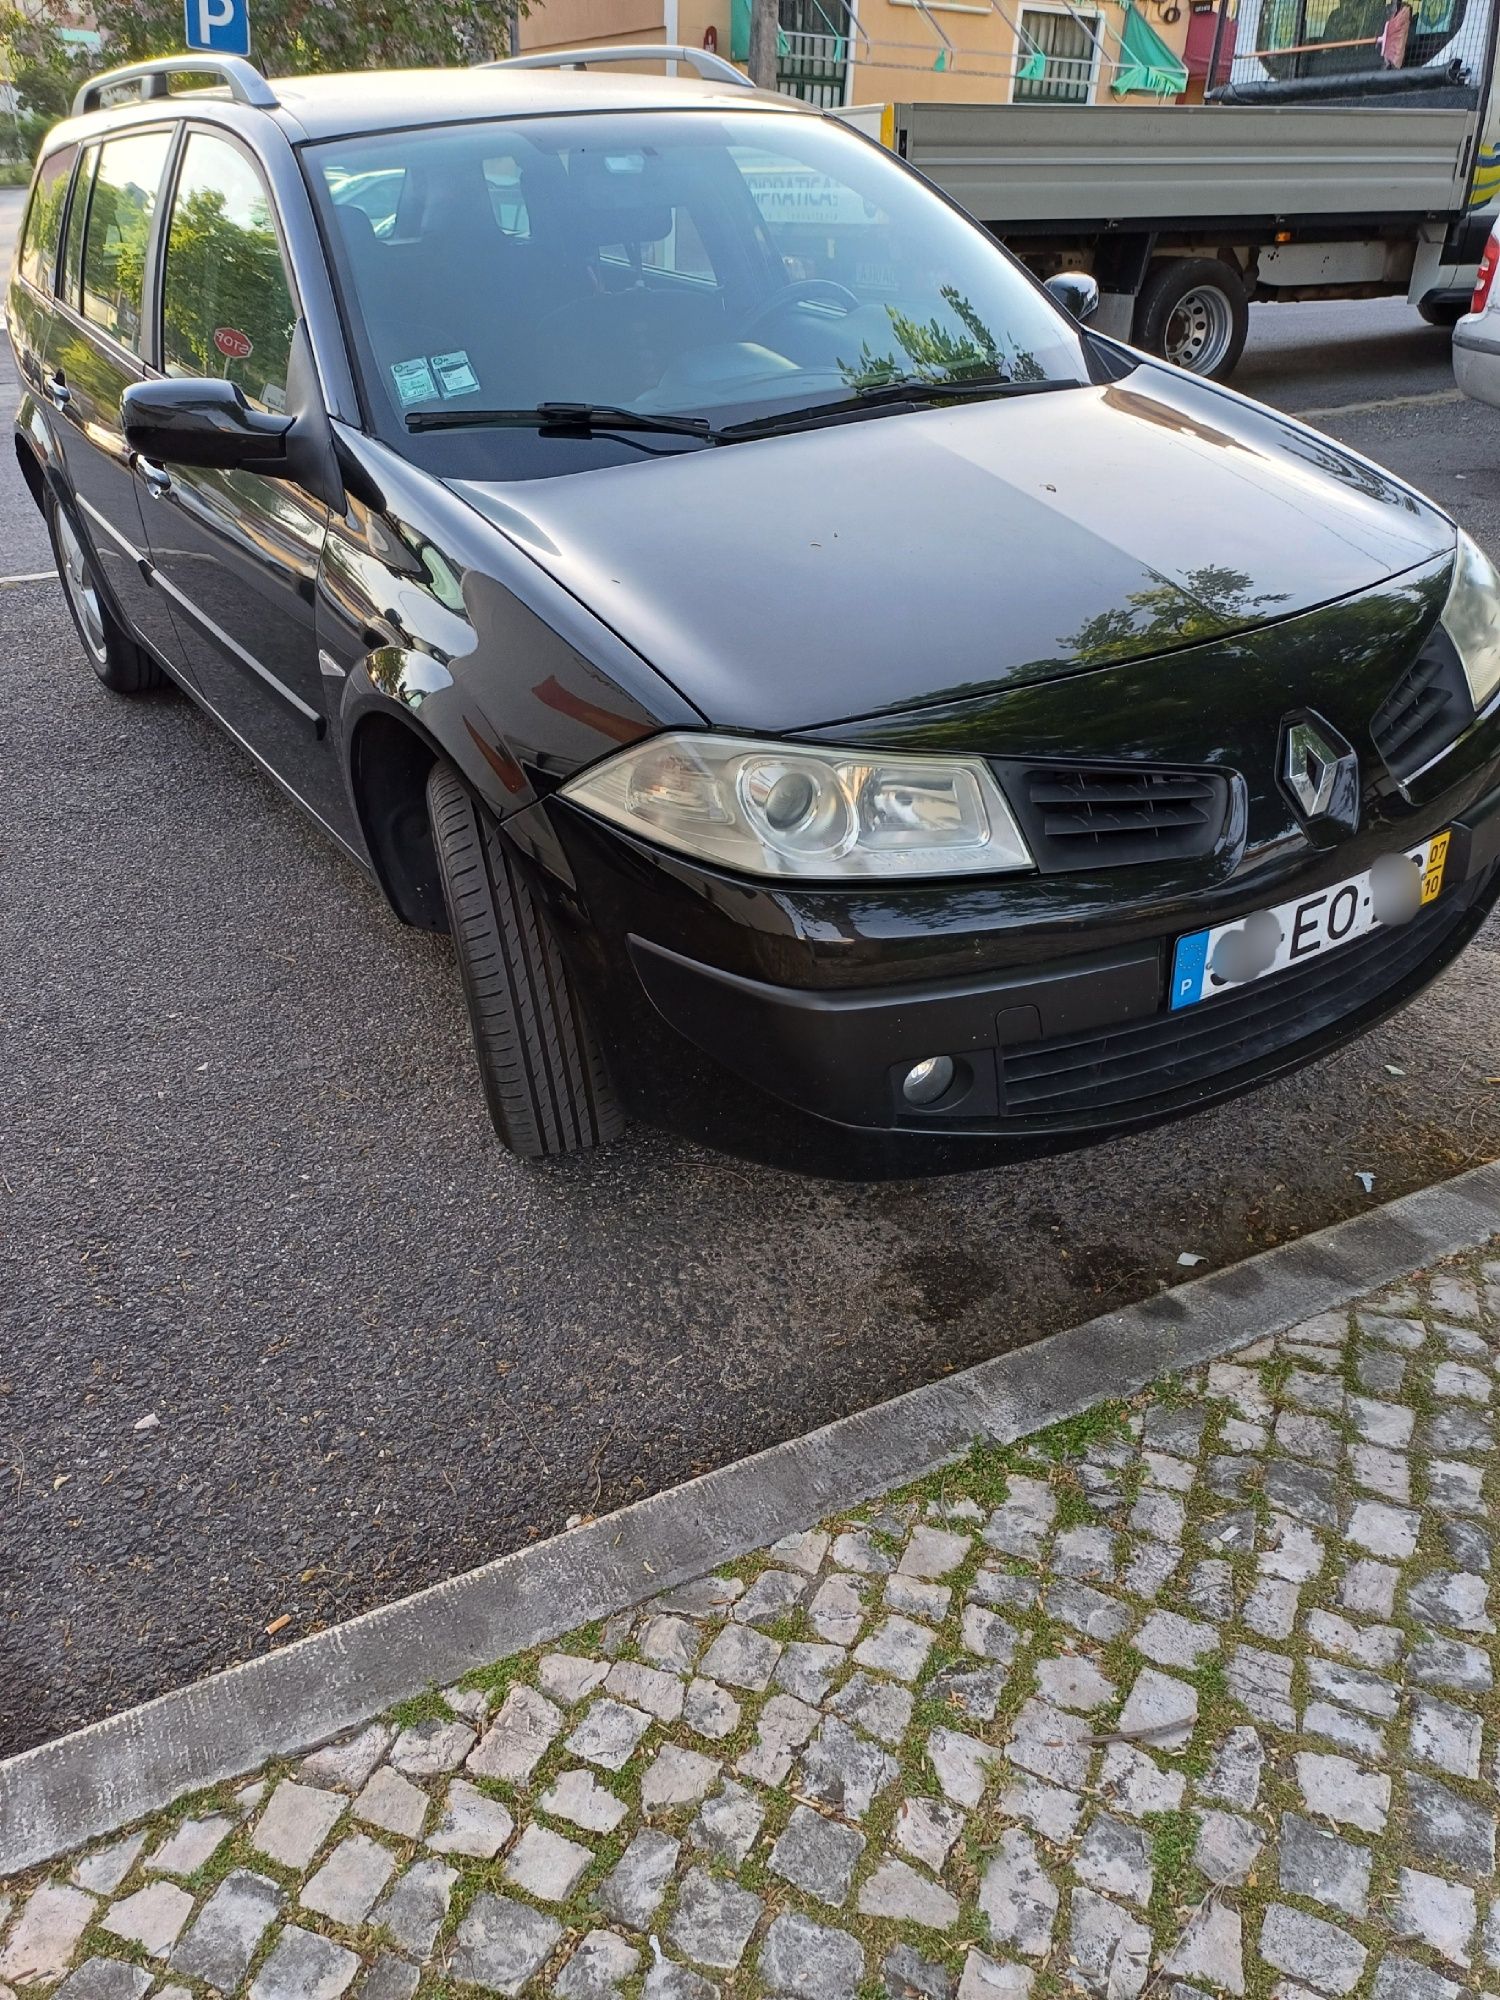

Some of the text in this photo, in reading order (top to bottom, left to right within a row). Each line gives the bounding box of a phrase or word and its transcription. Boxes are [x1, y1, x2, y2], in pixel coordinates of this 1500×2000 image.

[199, 0, 234, 44] P
[1429, 841, 1447, 864] 07
[1424, 875, 1439, 897] 10
[1180, 978, 1193, 996] P
